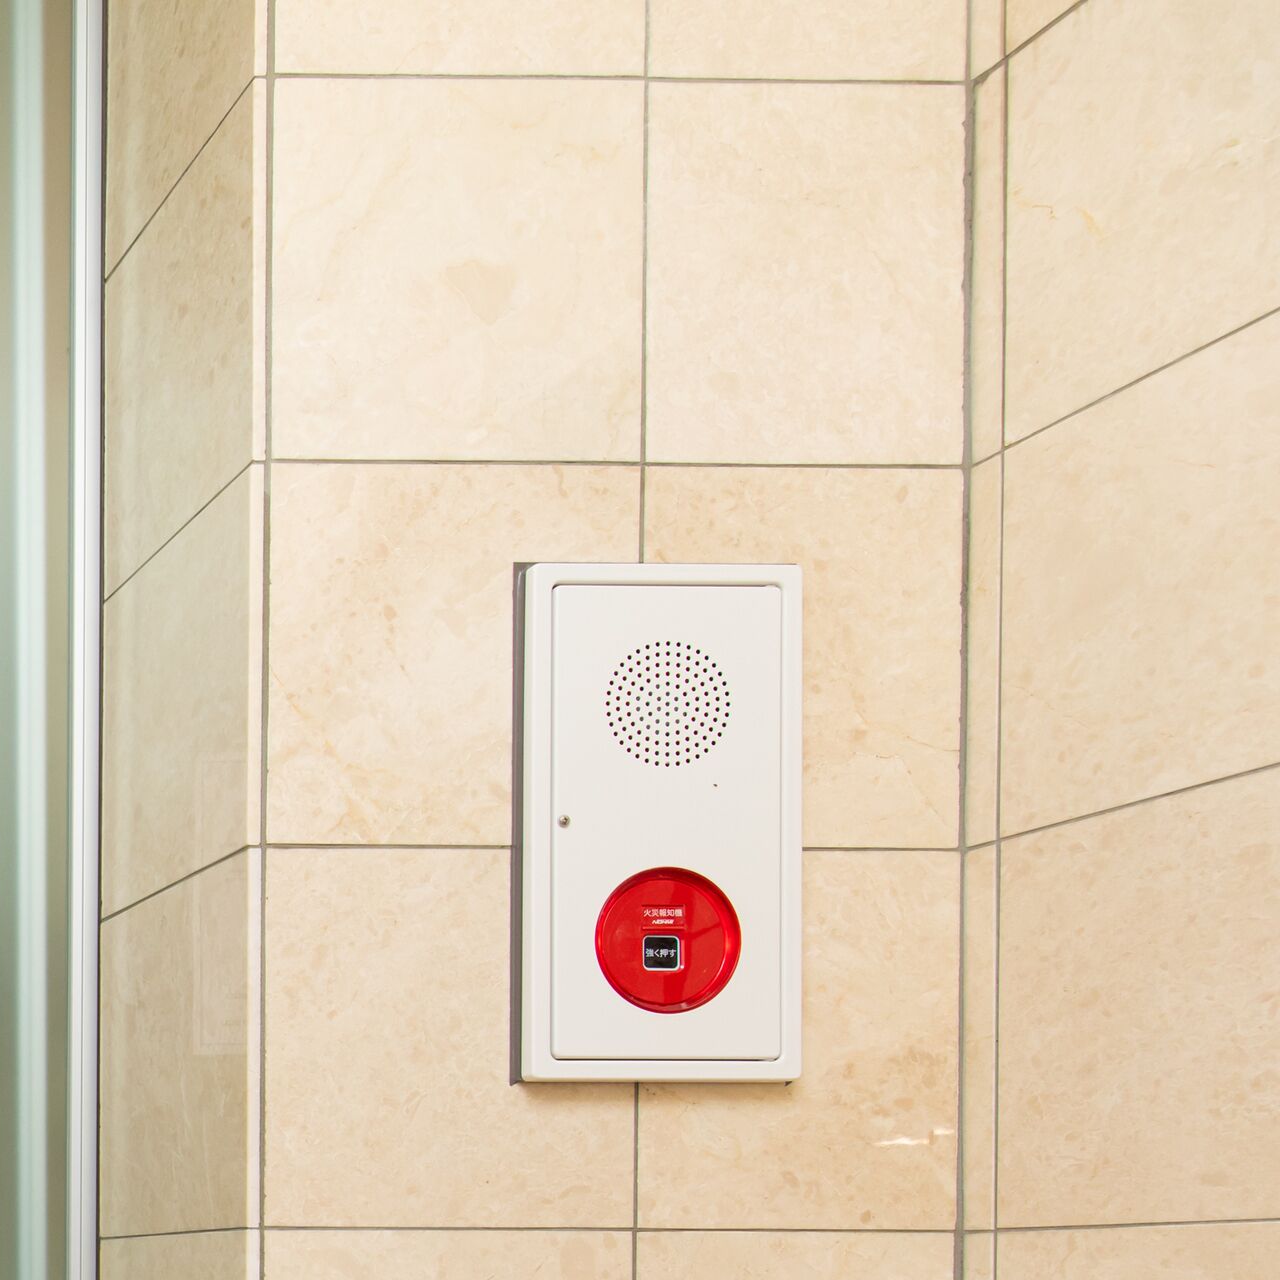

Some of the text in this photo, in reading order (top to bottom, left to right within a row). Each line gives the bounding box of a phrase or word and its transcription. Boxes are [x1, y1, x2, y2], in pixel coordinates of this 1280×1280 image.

[644, 908, 683, 917] 火災報知機
[646, 948, 676, 958] 強く押す
